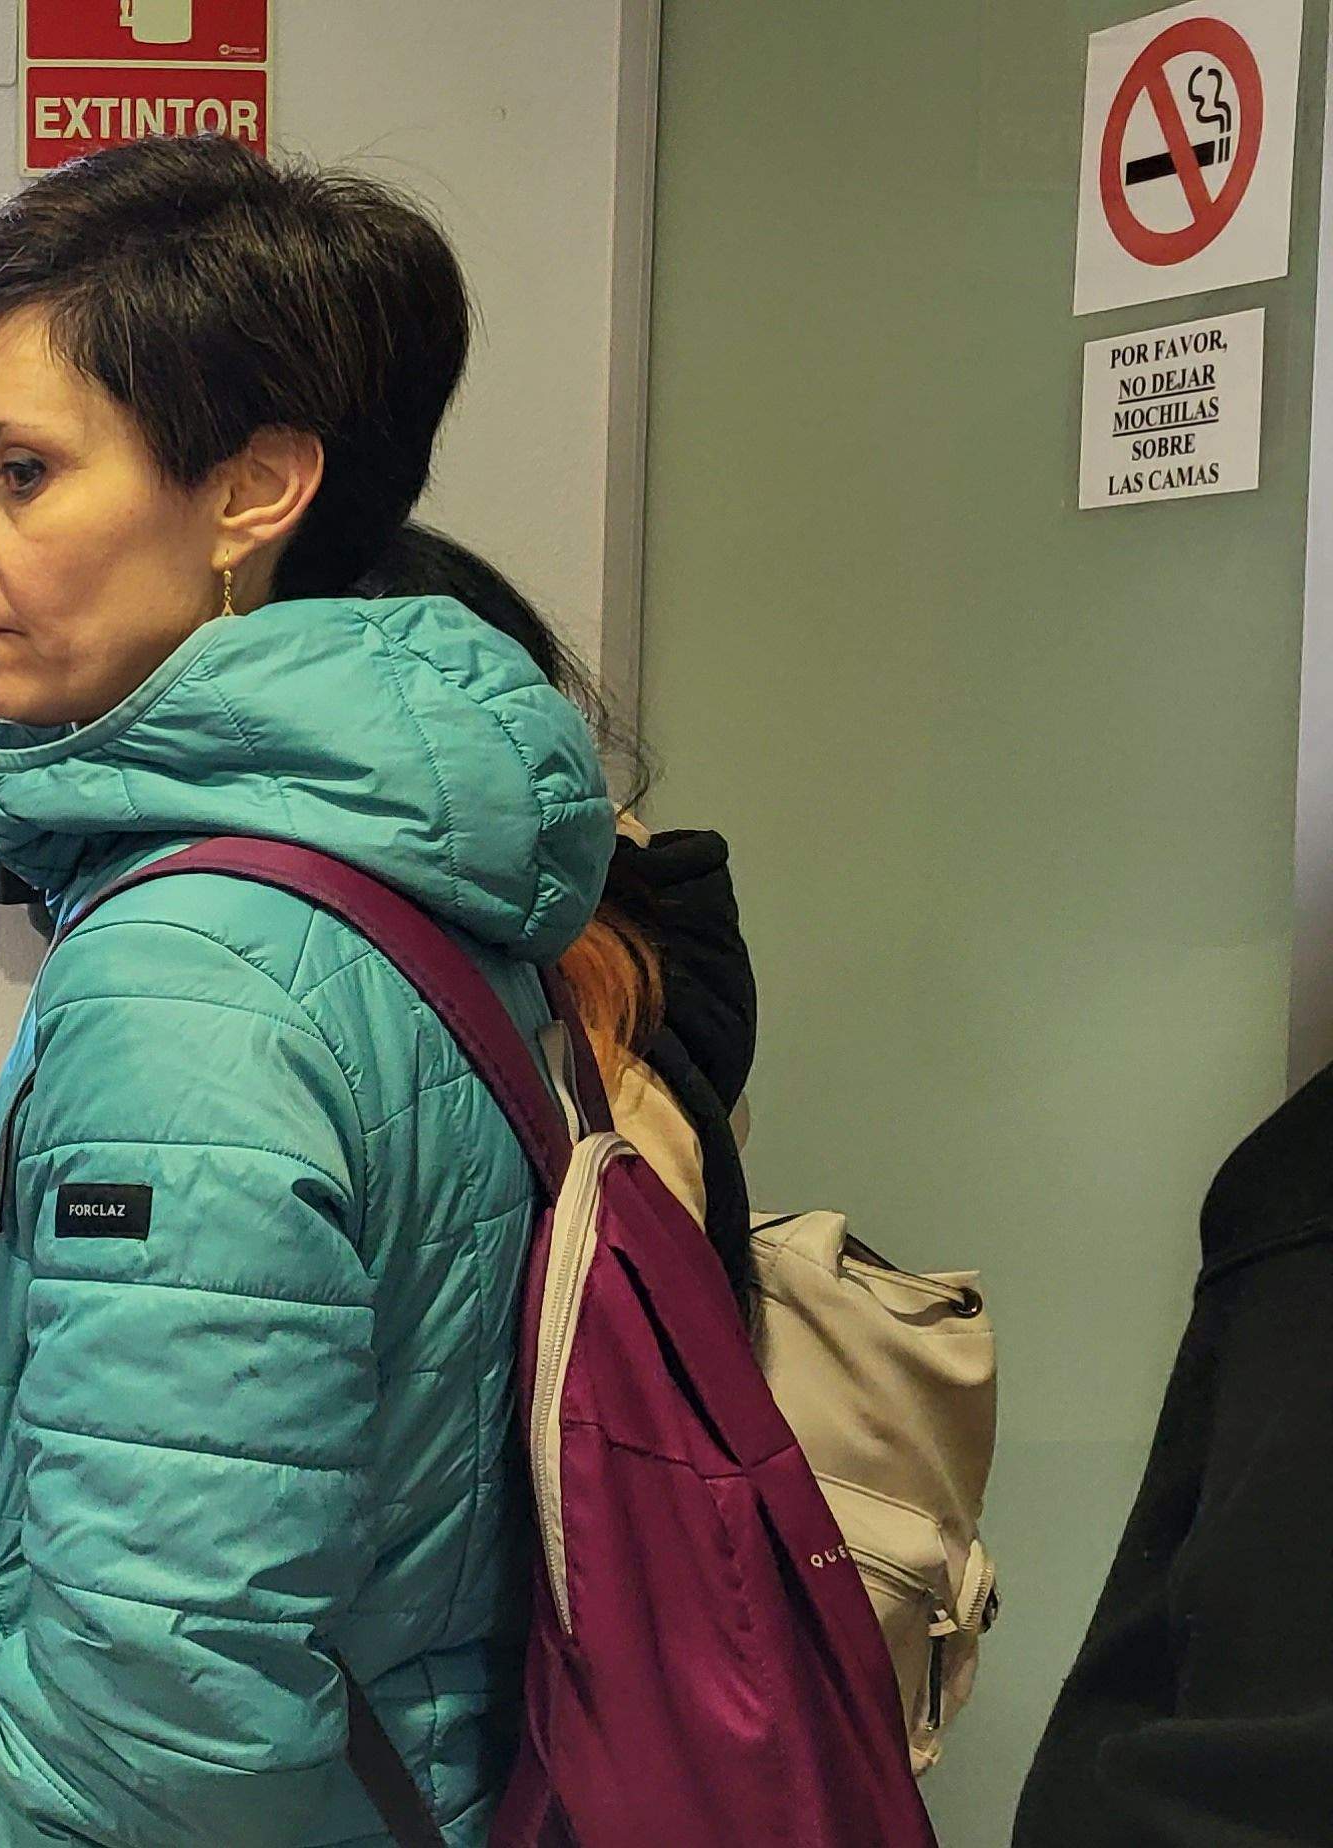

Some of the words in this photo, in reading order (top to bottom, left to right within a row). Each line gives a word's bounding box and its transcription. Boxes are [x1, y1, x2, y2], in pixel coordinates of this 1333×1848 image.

[35, 97, 258, 142] EXTINTOR
[1110, 343, 1148, 369] POR
[1154, 329, 1228, 361] FAVOR,
[1118, 376, 1146, 399] NO
[1152, 364, 1215, 394] DEJAR
[1113, 397, 1219, 432] MOCHILAS
[1132, 433, 1195, 461] SOBRE
[1108, 472, 1143, 496] LAS
[1148, 463, 1219, 491] CAMAS
[68, 1204, 126, 1217] FORCLAZ
